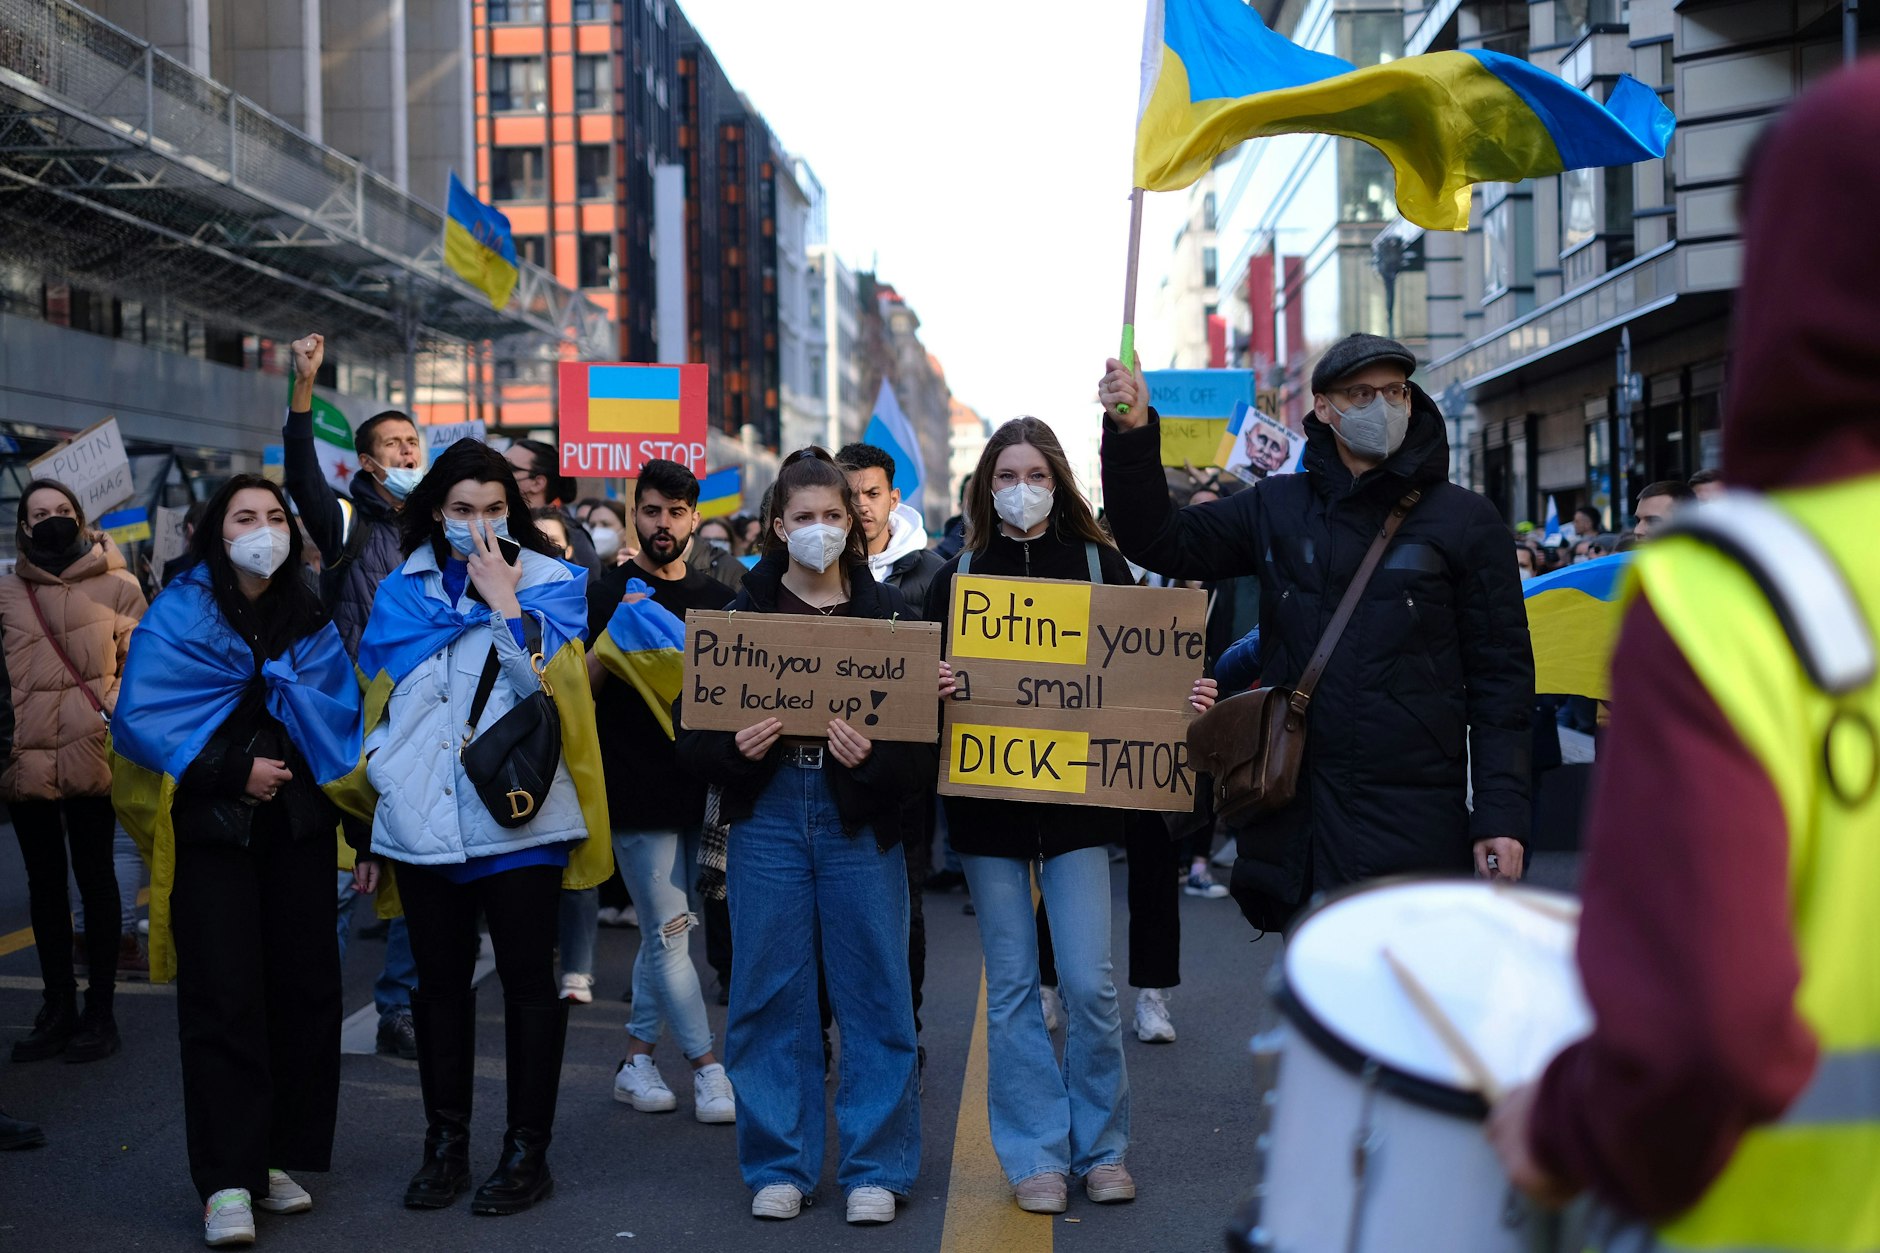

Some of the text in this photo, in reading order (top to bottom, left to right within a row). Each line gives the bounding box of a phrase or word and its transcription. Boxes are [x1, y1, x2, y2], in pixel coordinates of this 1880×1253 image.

[1151, 386, 1218, 404] NDS OFF
[53, 430, 111, 480] PUTIN
[563, 440, 705, 472] PUTIN STOP
[89, 470, 123, 503] HAAG
[1096, 616, 1202, 669] you're
[776, 654, 821, 680] you
[835, 656, 905, 680] should
[694, 674, 727, 706] be
[740, 683, 814, 710] locked
[950, 670, 1103, 709] a small
[505, 787, 535, 820] D
